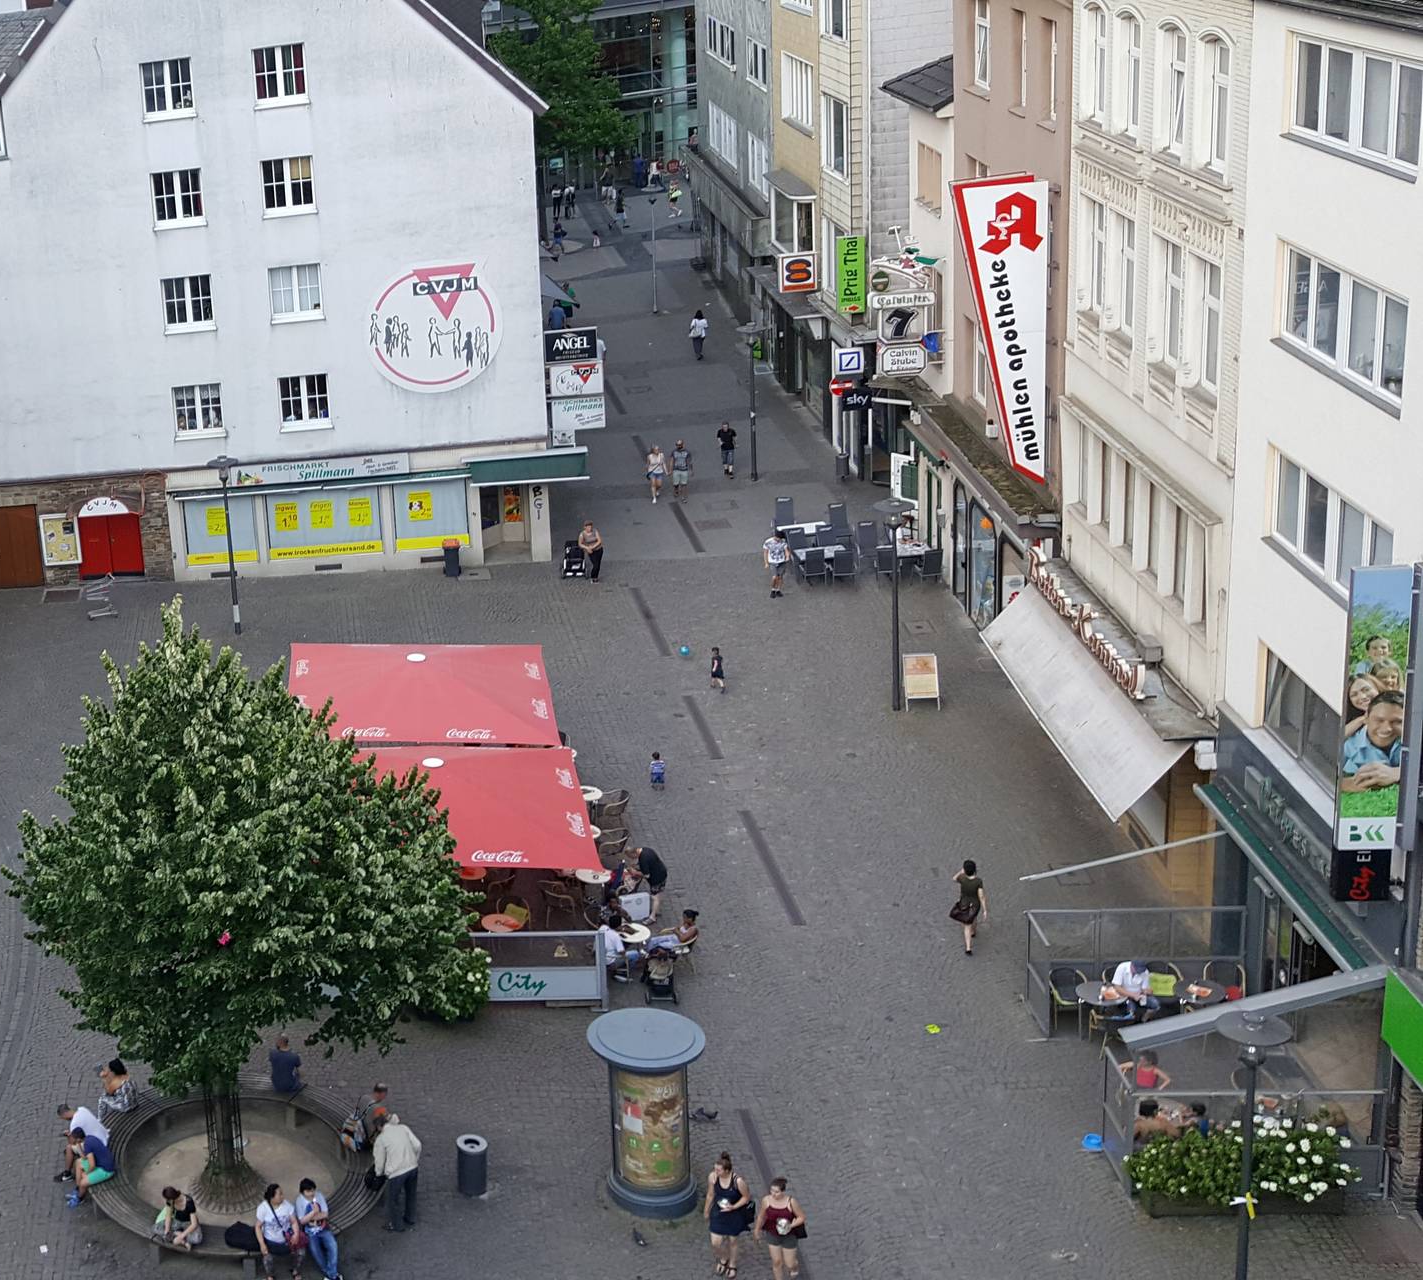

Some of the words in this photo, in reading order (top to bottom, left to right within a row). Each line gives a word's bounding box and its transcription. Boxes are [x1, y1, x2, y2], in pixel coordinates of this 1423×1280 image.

[843, 236, 858, 262] Thai
[416, 277, 475, 294] CVJM
[843, 269, 858, 296] Prig
[989, 259, 1027, 371] apotheke
[885, 307, 918, 339] 7
[553, 336, 591, 351] ANGEL
[889, 349, 918, 358] Calvin
[846, 393, 869, 405] sky
[562, 403, 603, 412] Spillmann
[1012, 378, 1040, 461] mühlen
[262, 461, 330, 473] FRISCHMARKT
[297, 467, 355, 480] Spillmann
[87, 499, 118, 512] CVJM
[276, 544, 376, 557] www.trockenfruchtversand.de
[446, 728, 492, 738] Coca-Cola
[471, 850, 524, 863] Coca-Cola
[498, 972, 547, 996] City
